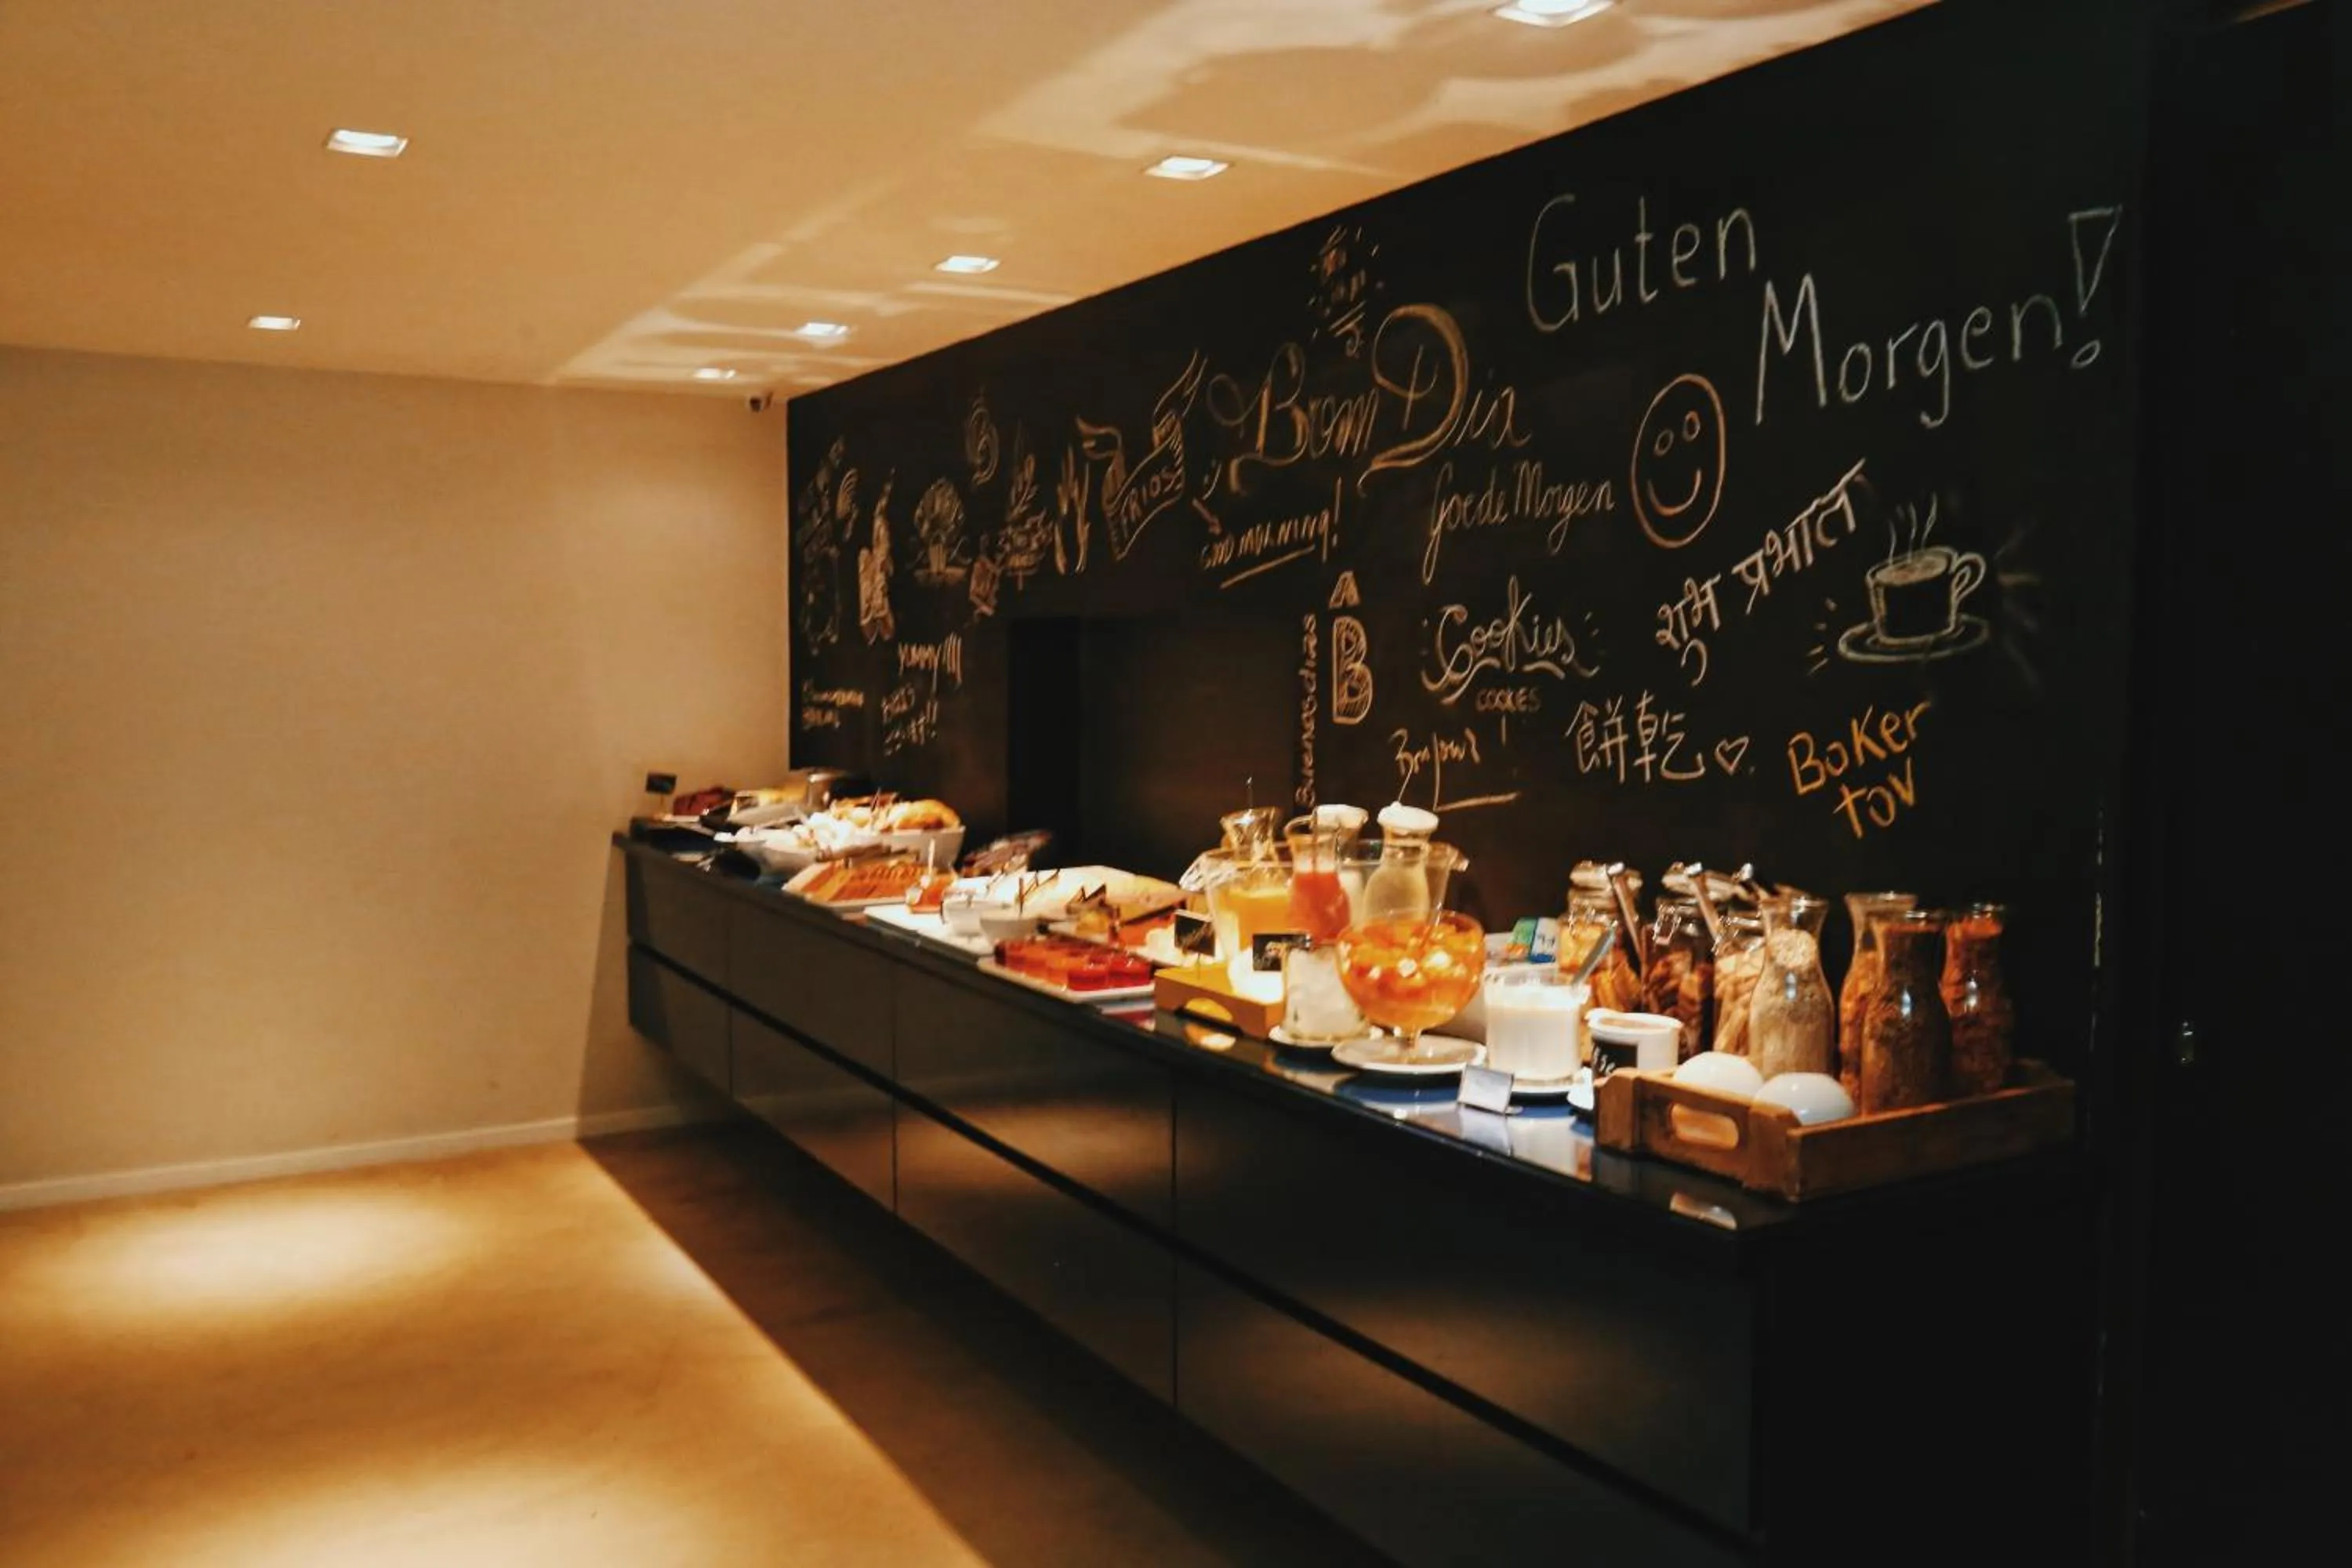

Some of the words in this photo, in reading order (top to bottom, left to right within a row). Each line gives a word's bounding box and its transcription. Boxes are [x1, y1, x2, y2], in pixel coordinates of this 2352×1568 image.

[1526, 193, 1757, 333] Guten
[1754, 204, 2123, 429] Morgen!
[1358, 302, 1532, 499] Dia
[1512, 459, 1616, 556] Morgen
[1654, 572, 1722, 687] शुभ
[1730, 456, 1867, 615] प्रभात
[1421, 574, 1601, 693] Cookies
[1565, 691, 1706, 784] 餅乾
